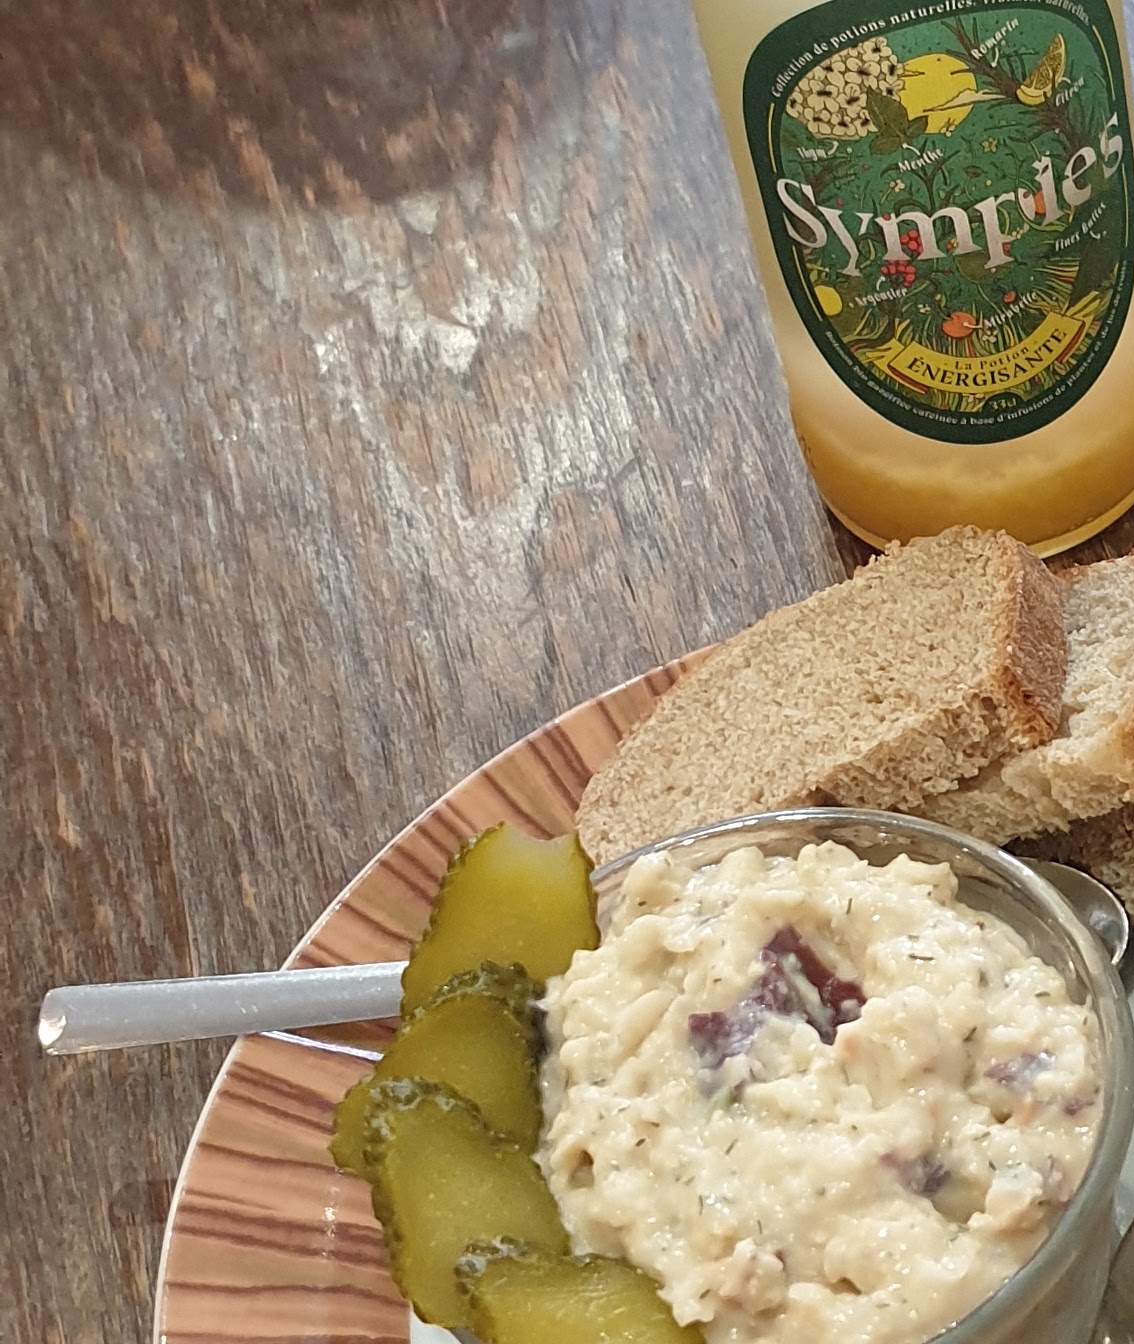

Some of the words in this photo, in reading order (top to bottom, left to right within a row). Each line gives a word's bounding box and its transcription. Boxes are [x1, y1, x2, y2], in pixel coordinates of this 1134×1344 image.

[970, 17, 1020, 60] Romarin
[771, 49, 814, 98] Collection
[813, 41, 829, 56] de
[830, 19, 886, 48] potions
[898, 147, 944, 172] Menthe
[984, 292, 1039, 328] Mirabelle
[907, 328, 1067, 387] ÉNERGISANTE
[955, 361, 972, 370] La
[980, 347, 1029, 370] Potion
[970, 414, 994, 425] base
